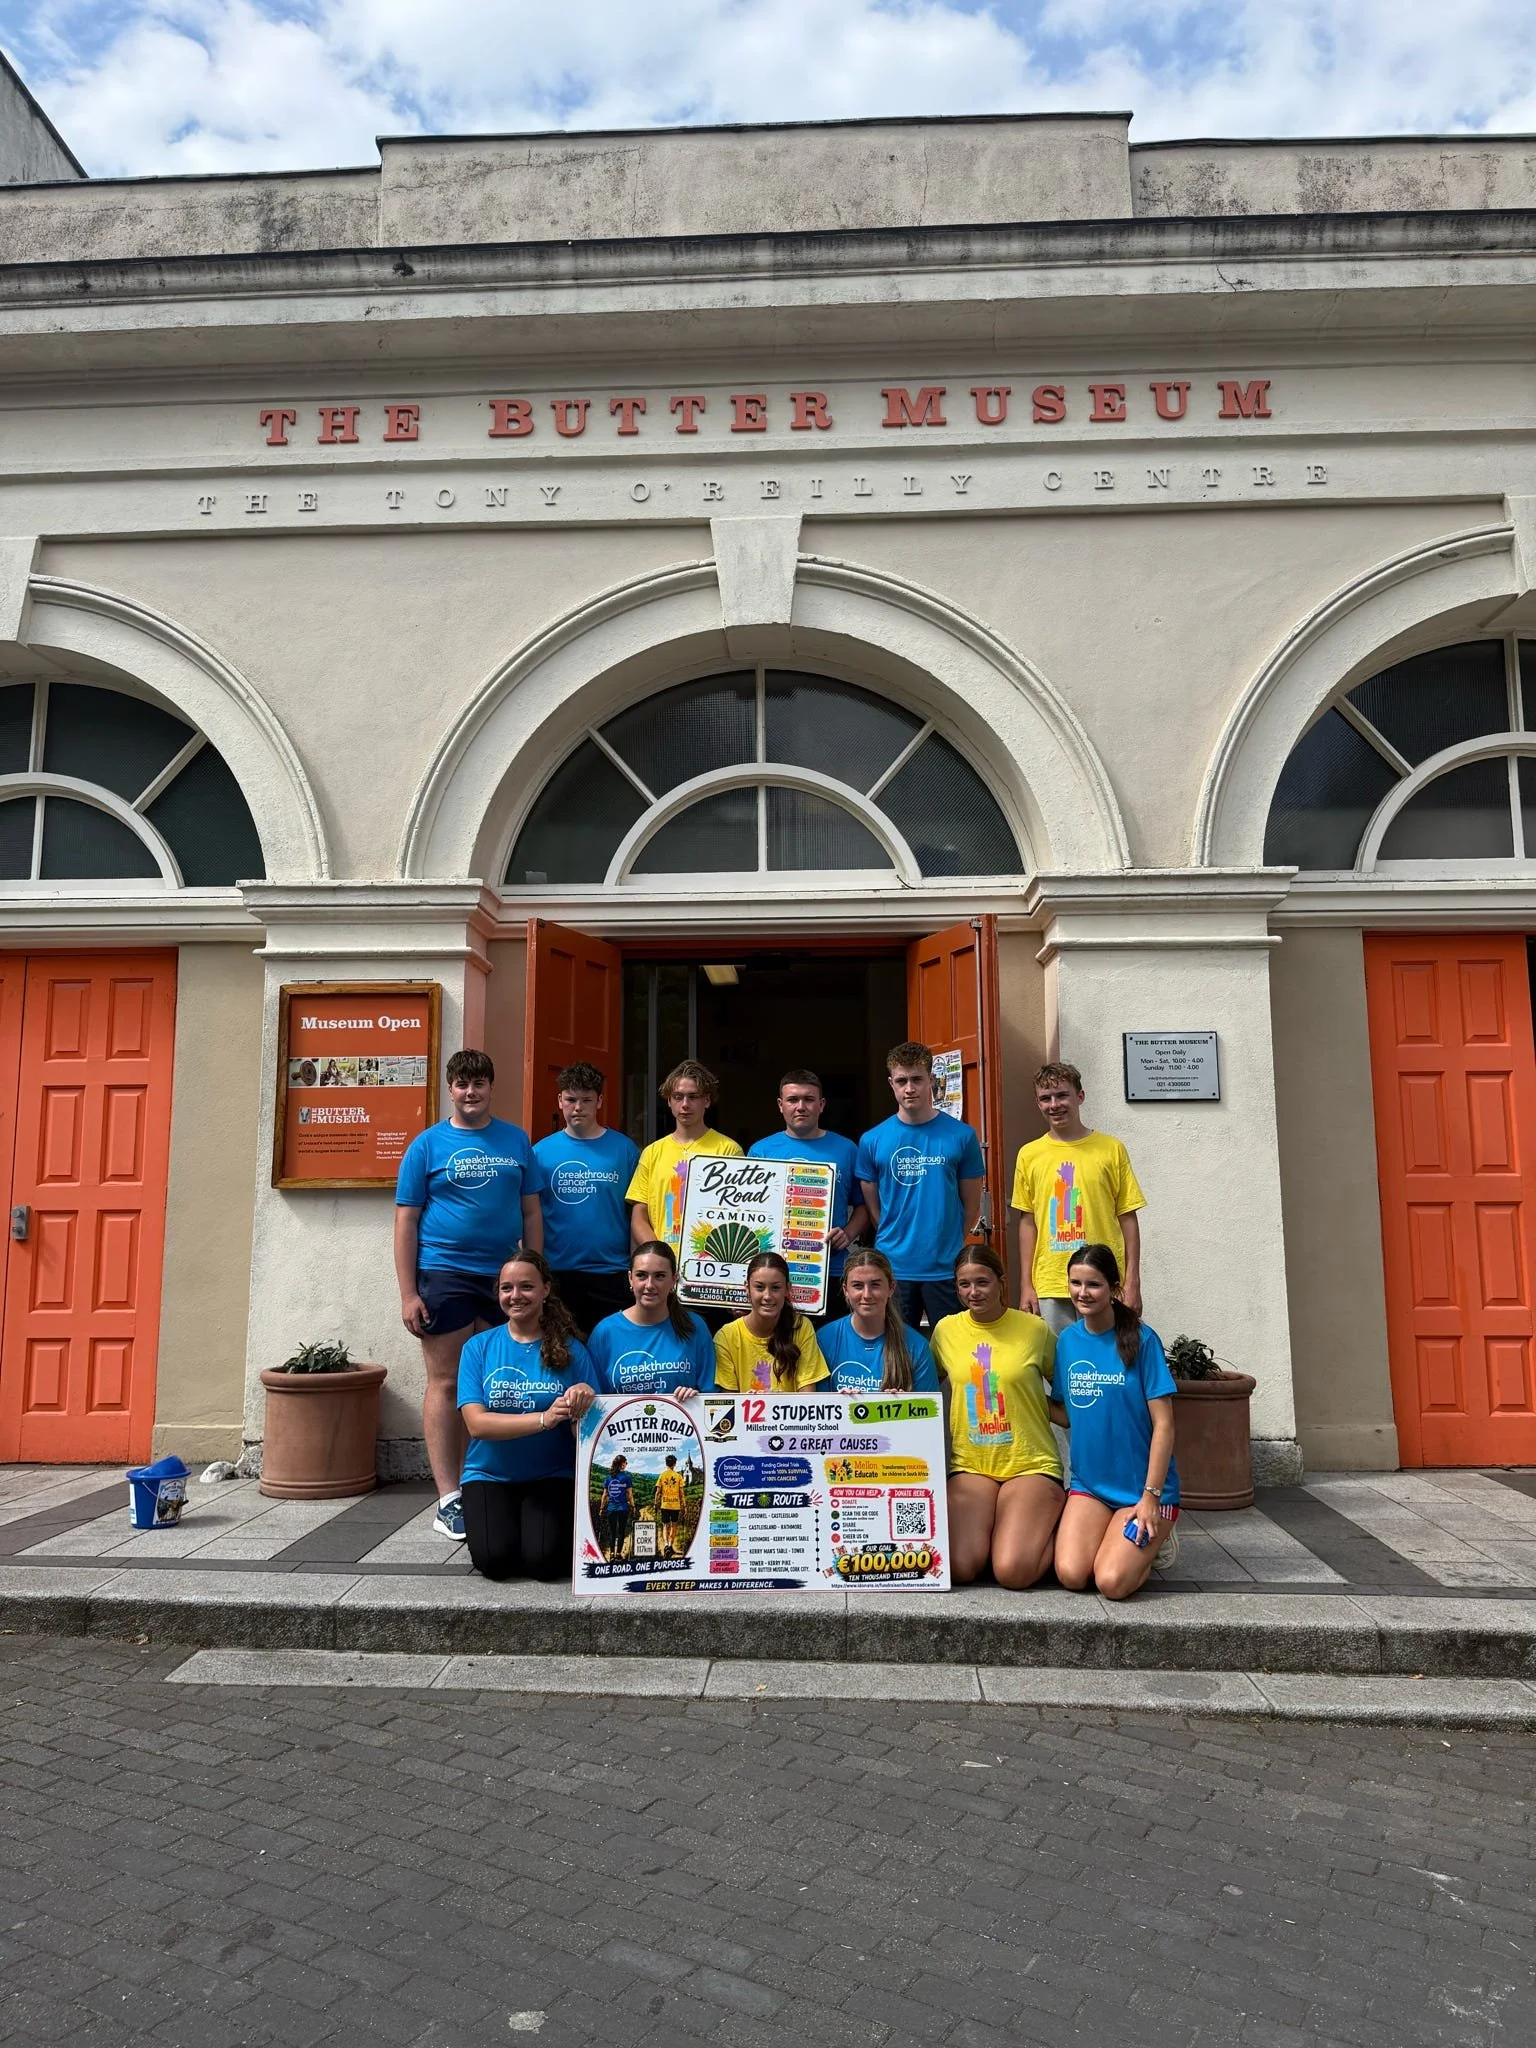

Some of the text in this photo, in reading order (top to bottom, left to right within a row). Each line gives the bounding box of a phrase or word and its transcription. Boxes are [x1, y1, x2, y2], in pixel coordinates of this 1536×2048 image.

[260, 379, 1273, 446] THE BUTTER MUSEUM
[199, 464, 1328, 514] THE TONY O'REILLY CENTRE
[301, 1015, 421, 1032] Museum Open
[318, 1107, 365, 1116] BUTTER
[317, 1115, 370, 1124] MUSEUM
[454, 1156, 518, 1167] breakthrough
[897, 1155, 945, 1165] breakthrough
[454, 1163, 487, 1172] cancer
[898, 1168, 927, 1177] research
[454, 1168, 498, 1180] research
[558, 1170, 618, 1183] breakthrough
[700, 1161, 776, 1192] Butter
[558, 1184, 597, 1194] research
[716, 1186, 770, 1207] Road
[706, 1210, 766, 1223] CAMINO
[1057, 1224, 1086, 1242] Mellon
[691, 1287, 727, 1295] MILLSTREET
[620, 1360, 690, 1374] breakthrough
[620, 1372, 655, 1383] cancer
[838, 1372, 882, 1385] breakthr
[1070, 1371, 1125, 1384] breakthrough
[490, 1378, 564, 1393] breakthrough
[621, 1379, 666, 1393] research
[1070, 1380, 1095, 1388] cancer
[489, 1390, 525, 1399] cancer
[1070, 1388, 1103, 1397] research
[488, 1398, 535, 1408] research
[741, 1399, 842, 1423] 12 STUDENTS
[876, 1403, 928, 1418] 117 km
[607, 1417, 694, 1437] BUTTER ROAD
[779, 1424, 816, 1432] Community
[979, 1414, 1012, 1434] Mellon
[632, 1432, 668, 1444] CAMINO
[789, 1438, 878, 1450] 2 GREAT CAUSES
[854, 1460, 878, 1470] Mellon
[854, 1470, 878, 1478] Educate
[732, 1494, 803, 1506] THE ROUTE
[595, 1560, 688, 1575] ONE ROAD. ONE PURPOSE.
[838, 1550, 930, 1573] €100,000
[646, 1582, 671, 1591] EVERY
[674, 1582, 696, 1590] STEP
